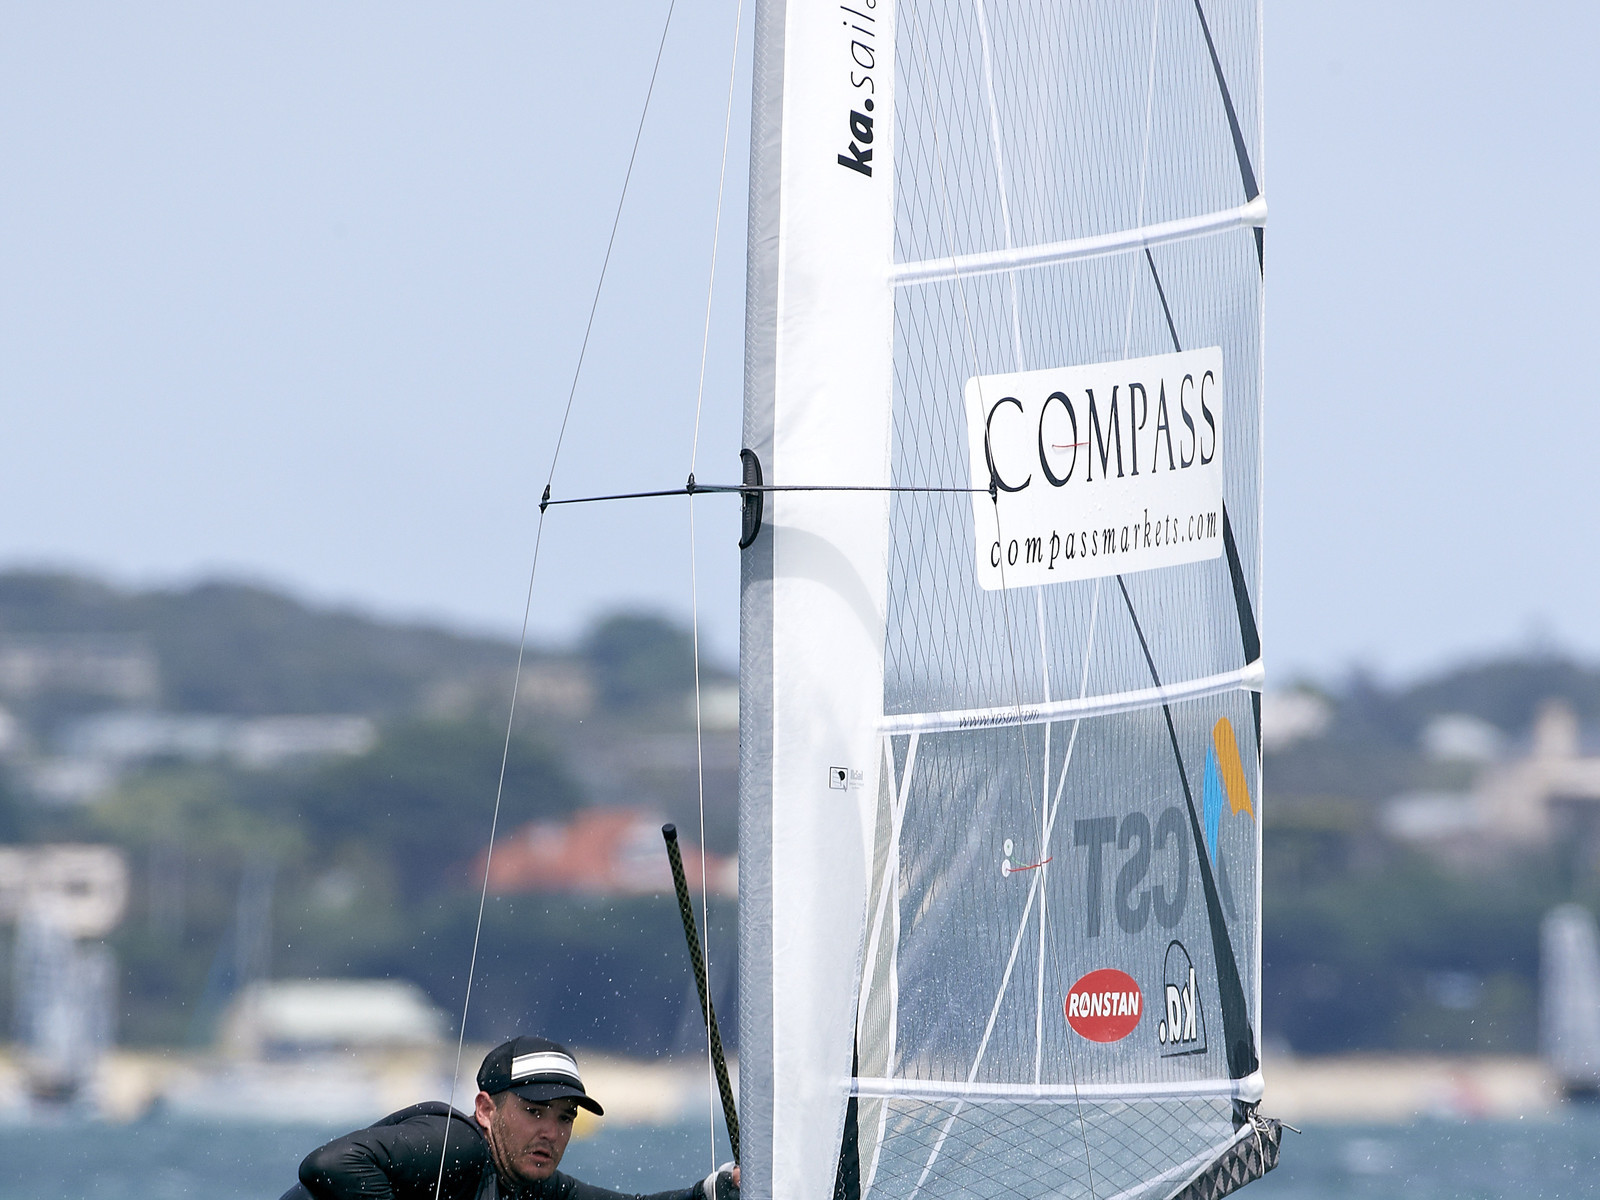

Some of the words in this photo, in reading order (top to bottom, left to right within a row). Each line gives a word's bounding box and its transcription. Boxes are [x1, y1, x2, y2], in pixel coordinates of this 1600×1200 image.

[984, 369, 1216, 493] COMPASS
[990, 508, 1217, 570] compassmarkets.com
[1068, 991, 1140, 1018] RONSTAN
